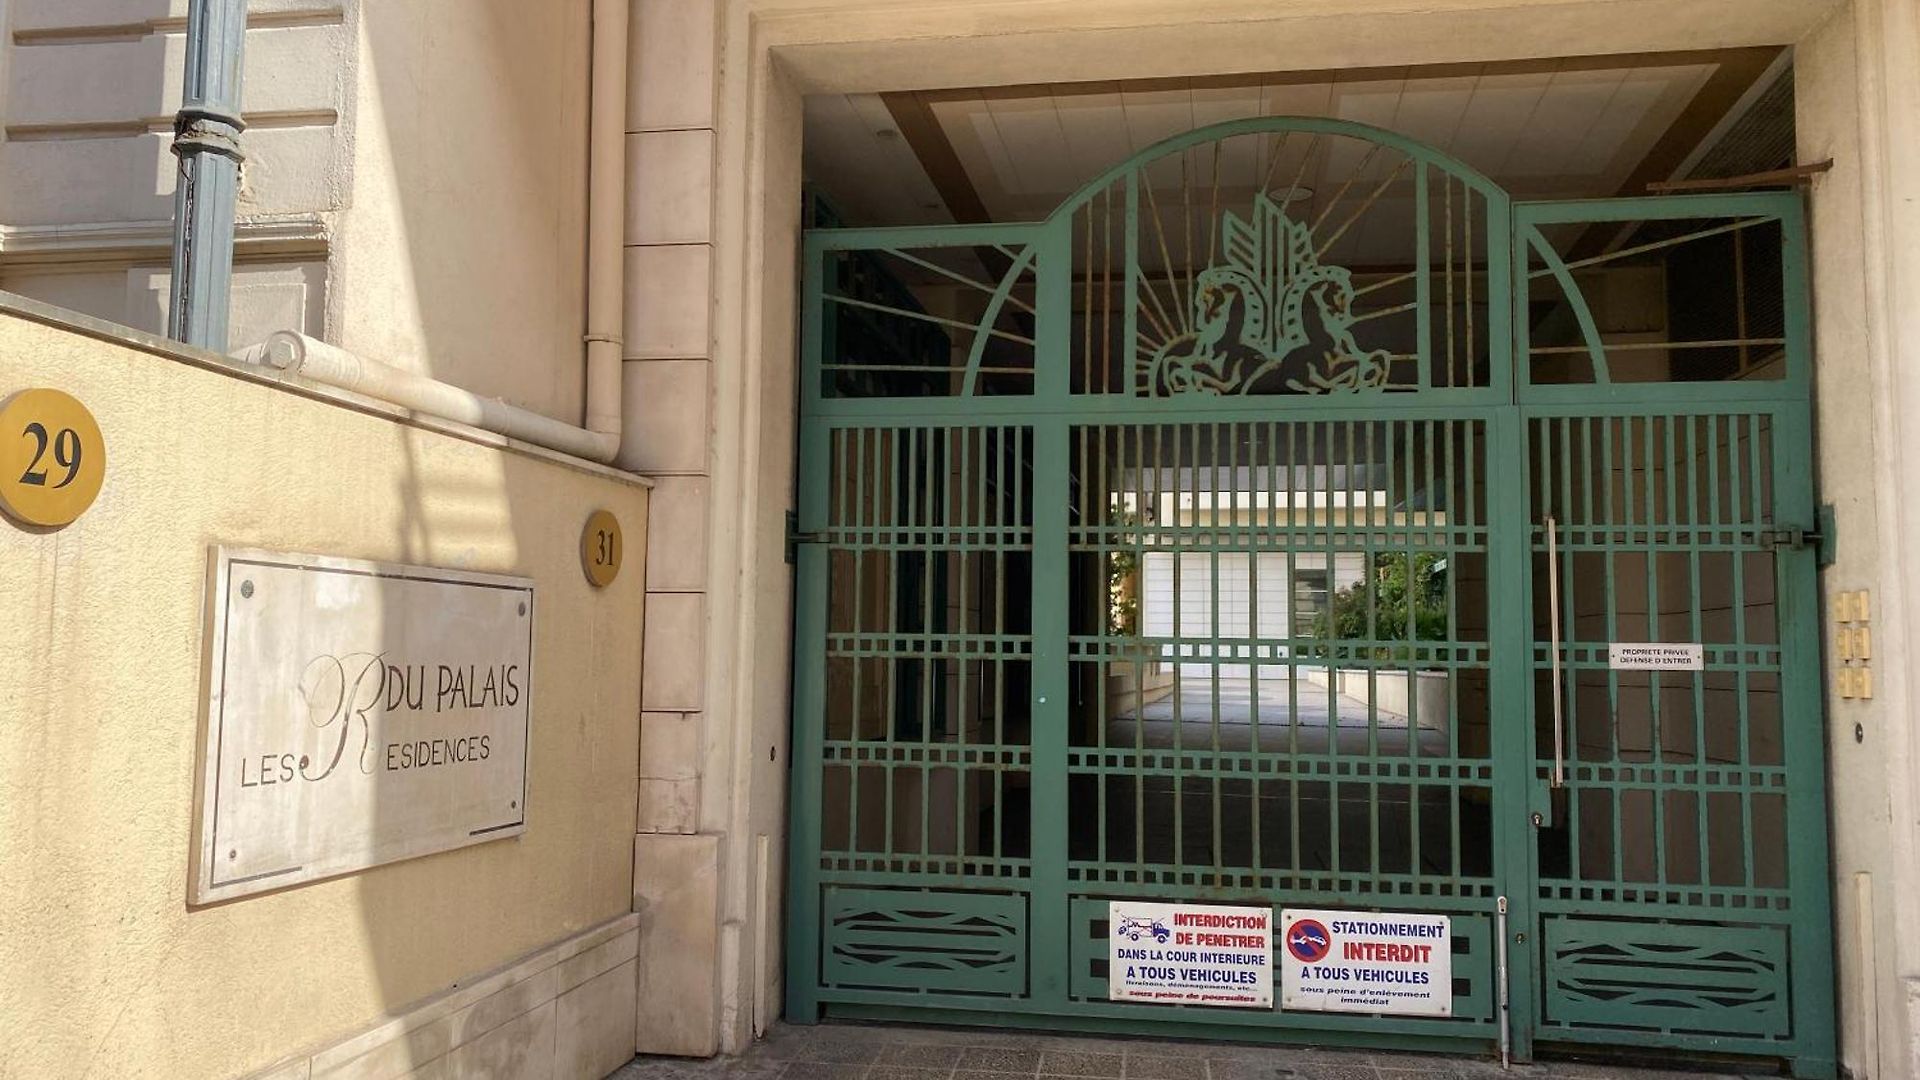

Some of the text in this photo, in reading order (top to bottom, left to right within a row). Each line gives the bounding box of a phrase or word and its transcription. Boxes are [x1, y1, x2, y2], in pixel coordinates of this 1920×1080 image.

[19, 422, 83, 490] 29
[595, 530, 615, 566] 31
[1622, 648, 1689, 656] PROPRIETE PRIVEE
[386, 664, 520, 713] DU PALAIS
[241, 753, 296, 788] LES
[1174, 913, 1267, 930] INTERDICTION
[1332, 921, 1444, 939] STATIONNEMENT
[1175, 932, 1265, 949] DE PENETRER
[1118, 949, 1265, 966] DANS LA COUR INTERIEURE
[1343, 942, 1432, 963] INTERDIT
[1126, 966, 1257, 984] A TOUS VEHICULES
[1301, 967, 1429, 984] A TOUS VEHICULES
[1155, 991, 1183, 999] peine
[1327, 988, 1356, 996] peine
